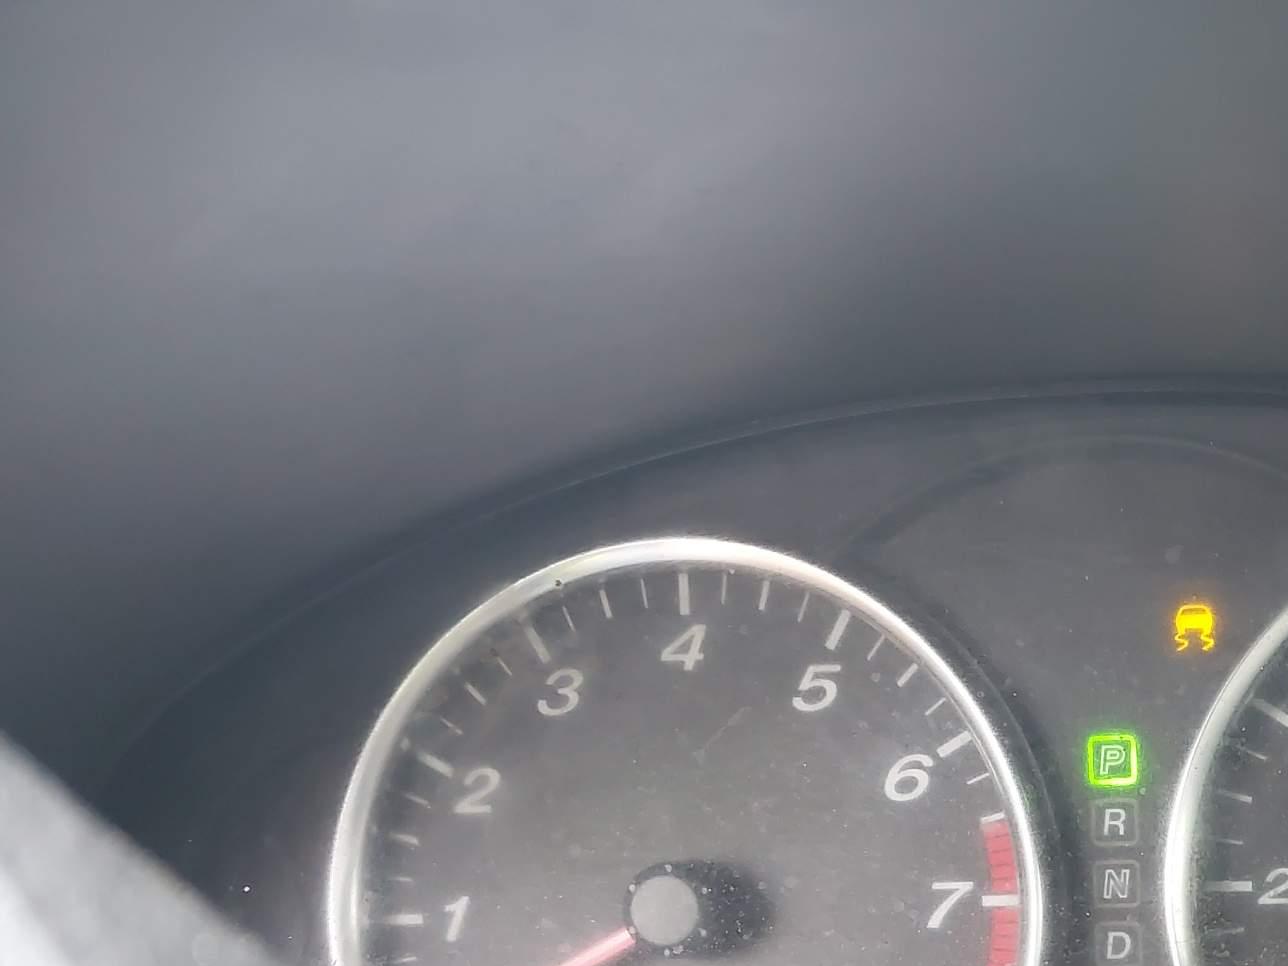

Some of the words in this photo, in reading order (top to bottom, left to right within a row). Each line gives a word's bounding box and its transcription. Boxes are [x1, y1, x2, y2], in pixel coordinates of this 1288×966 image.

[660, 624, 706, 671] 4
[536, 667, 584, 716] 3
[792, 663, 841, 712] 5
[884, 753, 932, 801] 6
[1100, 744, 1126, 775] P
[454, 768, 501, 814] 2
[1103, 808, 1127, 836] R
[927, 880, 974, 929] 7
[1103, 869, 1130, 899] N
[443, 896, 470, 942] 1
[1106, 931, 1132, 961] D
